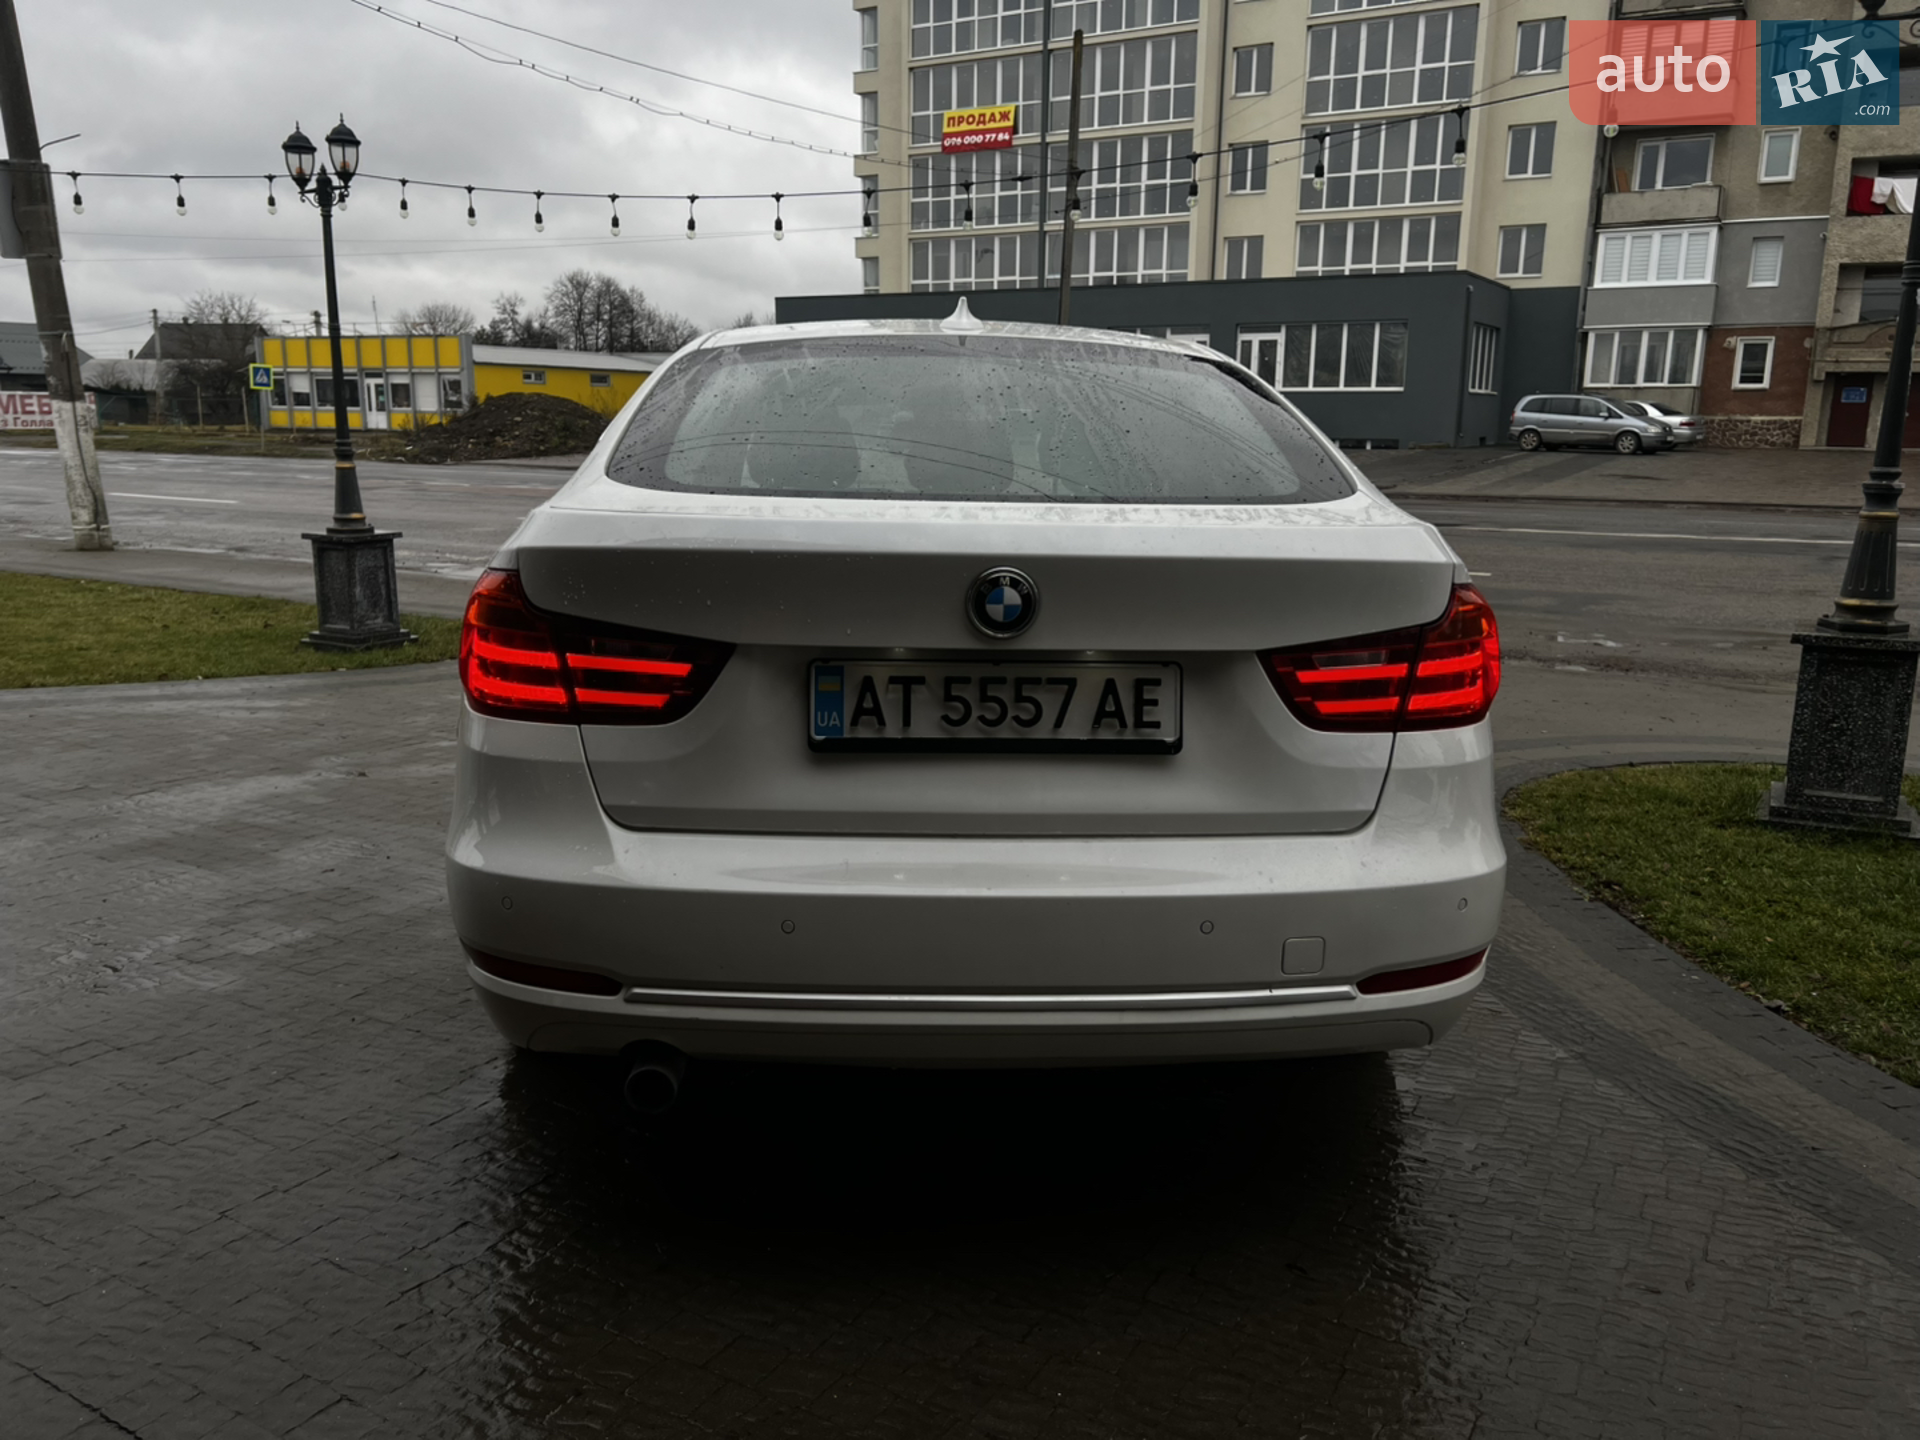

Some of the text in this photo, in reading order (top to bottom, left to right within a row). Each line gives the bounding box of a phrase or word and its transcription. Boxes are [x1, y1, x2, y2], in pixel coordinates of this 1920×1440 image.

[947, 110, 1011, 127] ПРОДАЖ
[963, 134, 984, 145] 000
[985, 132, 997, 143] 77
[997, 132, 1010, 141] 84
[980, 576, 1029, 596] BMW
[850, 675, 1163, 730] AT 5557 AE
[816, 711, 841, 728] UA
